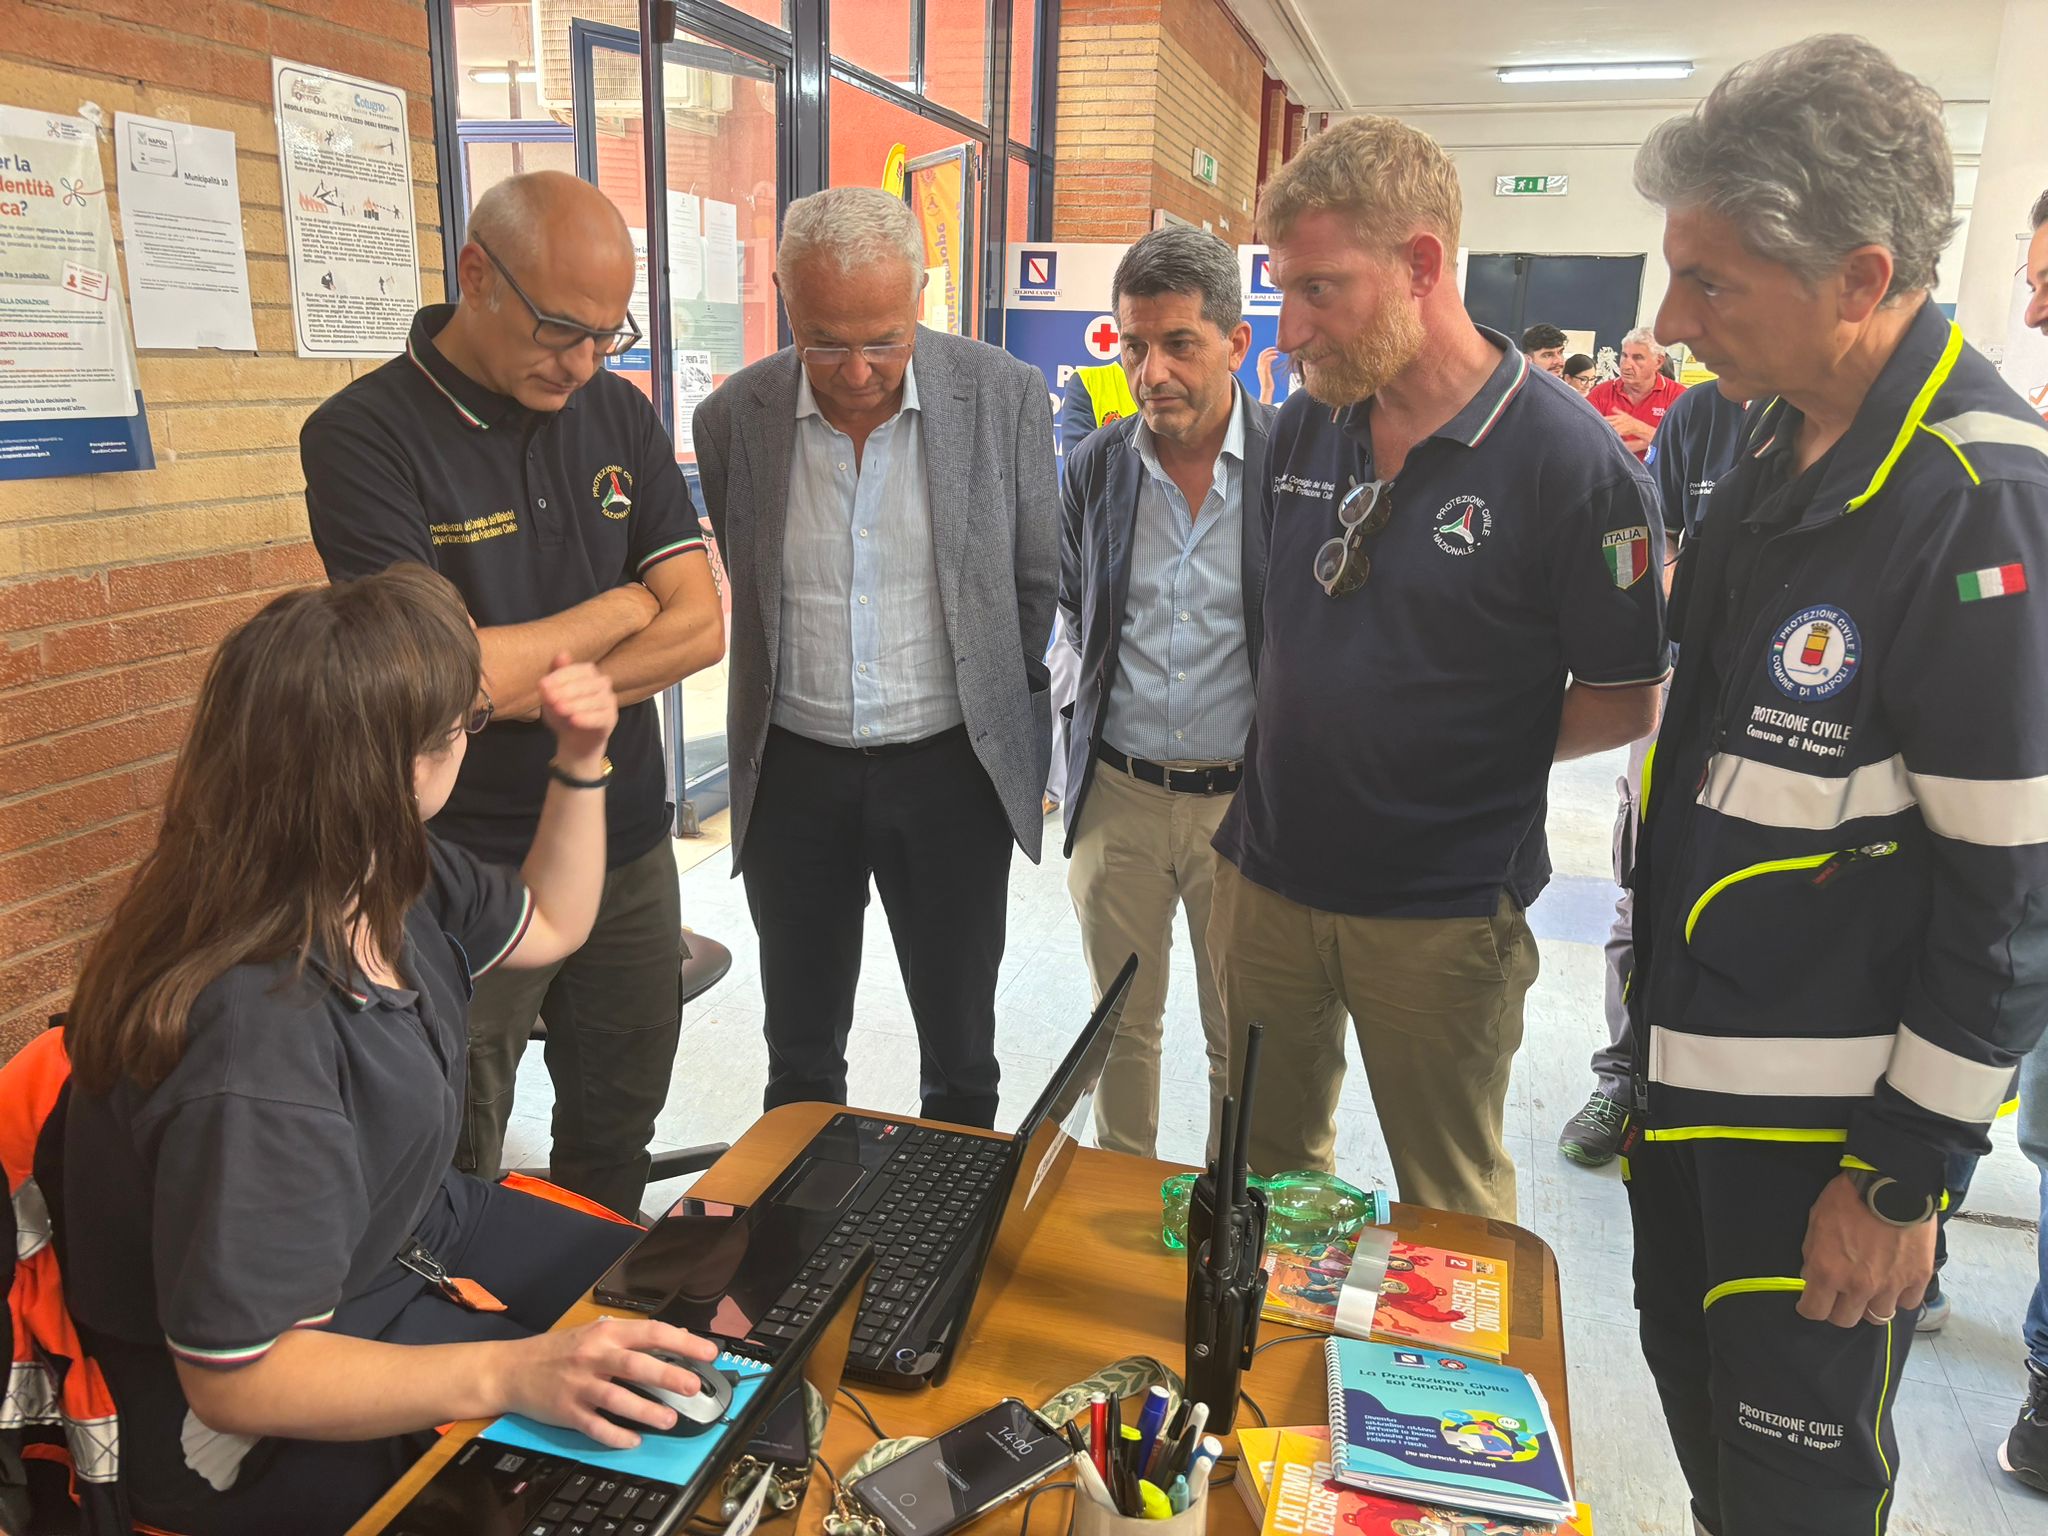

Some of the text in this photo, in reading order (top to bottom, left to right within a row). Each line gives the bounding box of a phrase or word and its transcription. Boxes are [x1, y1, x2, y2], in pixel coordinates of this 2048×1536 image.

[14, 154, 31, 172] la
[592, 465, 623, 498] PROTEZIONE
[1436, 495, 1492, 537] PROTEZIONE CIVILE
[1433, 533, 1475, 556] NAZIONALE
[1604, 528, 1641, 545] ITALIA
[1780, 609, 1855, 650] PROTEZIONE CIVILE
[1772, 655, 1849, 696] COMUNE DI NAPOLI
[1746, 724, 1846, 757] Comune di Napoli
[1811, 720, 1853, 740] CIVILE
[1450, 1258, 1468, 1267] 2
[1475, 1279, 1500, 1332] L'ATTIMO
[1359, 1369, 1510, 1393] La Protezione Civile
[1411, 1382, 1457, 1393] anche
[1464, 1388, 1486, 1397] tu!
[1365, 1421, 1405, 1429] cittadino
[1738, 1416, 1841, 1450] Comune di Napoli
[1739, 1401, 1844, 1437] PROTEZIONE CIVILE
[997, 1425, 1033, 1455] 14:00
[1274, 1462, 1312, 1534] L'ATTIMO
